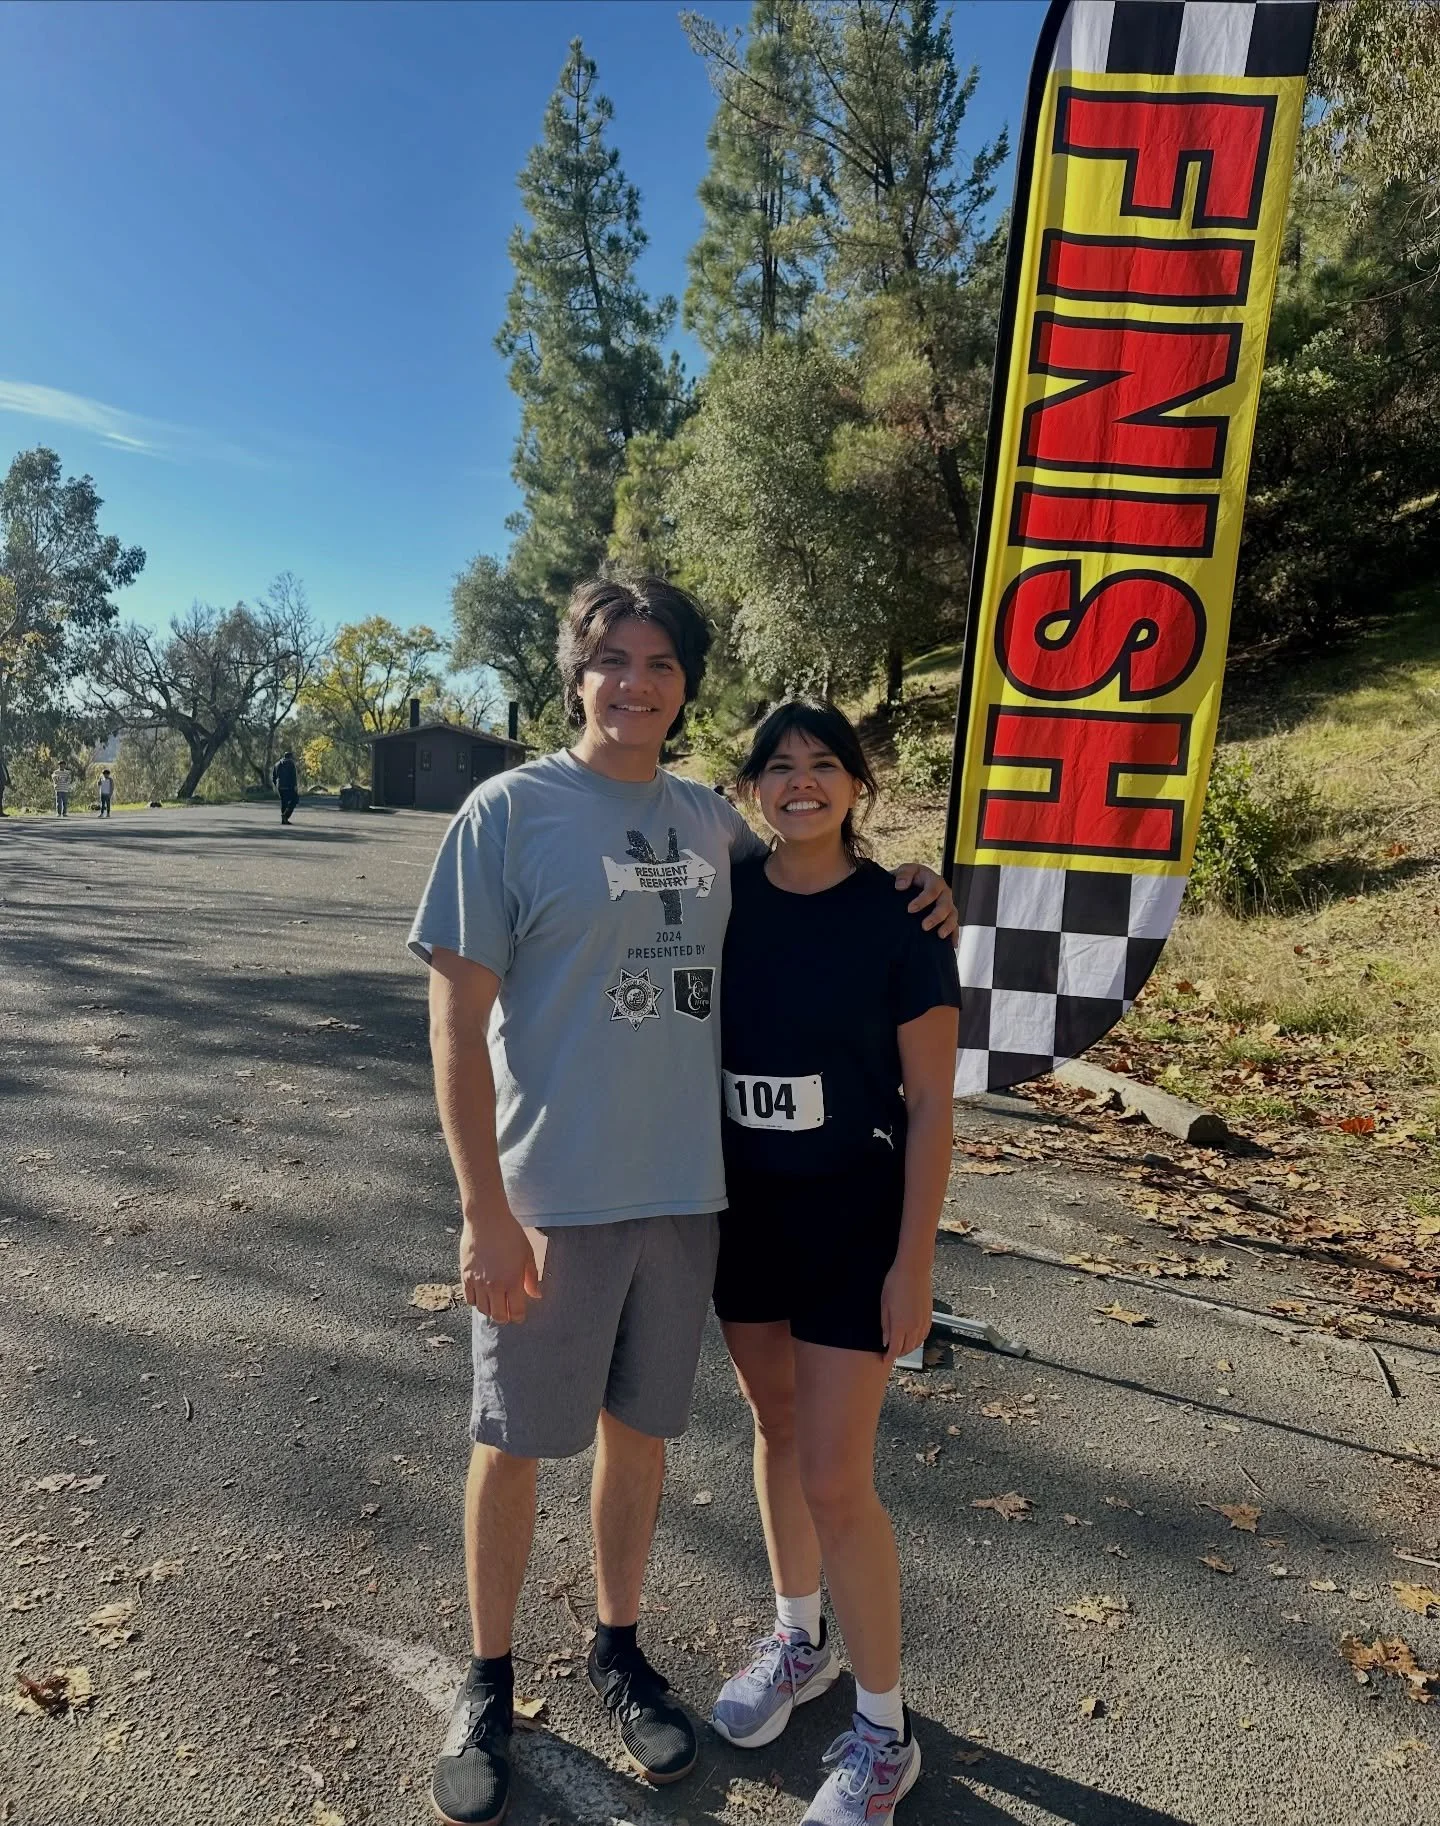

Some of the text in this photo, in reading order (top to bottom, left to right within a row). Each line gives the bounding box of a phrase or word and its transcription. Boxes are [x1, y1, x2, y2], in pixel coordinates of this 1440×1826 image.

[975, 86, 1278, 861] FINISH
[635, 865, 688, 877] RESILIENT
[640, 876, 688, 888] REENTRY
[656, 931, 682, 943] 2024
[627, 944, 706, 959] PRESENTED BY
[734, 1080, 797, 1120] 104
